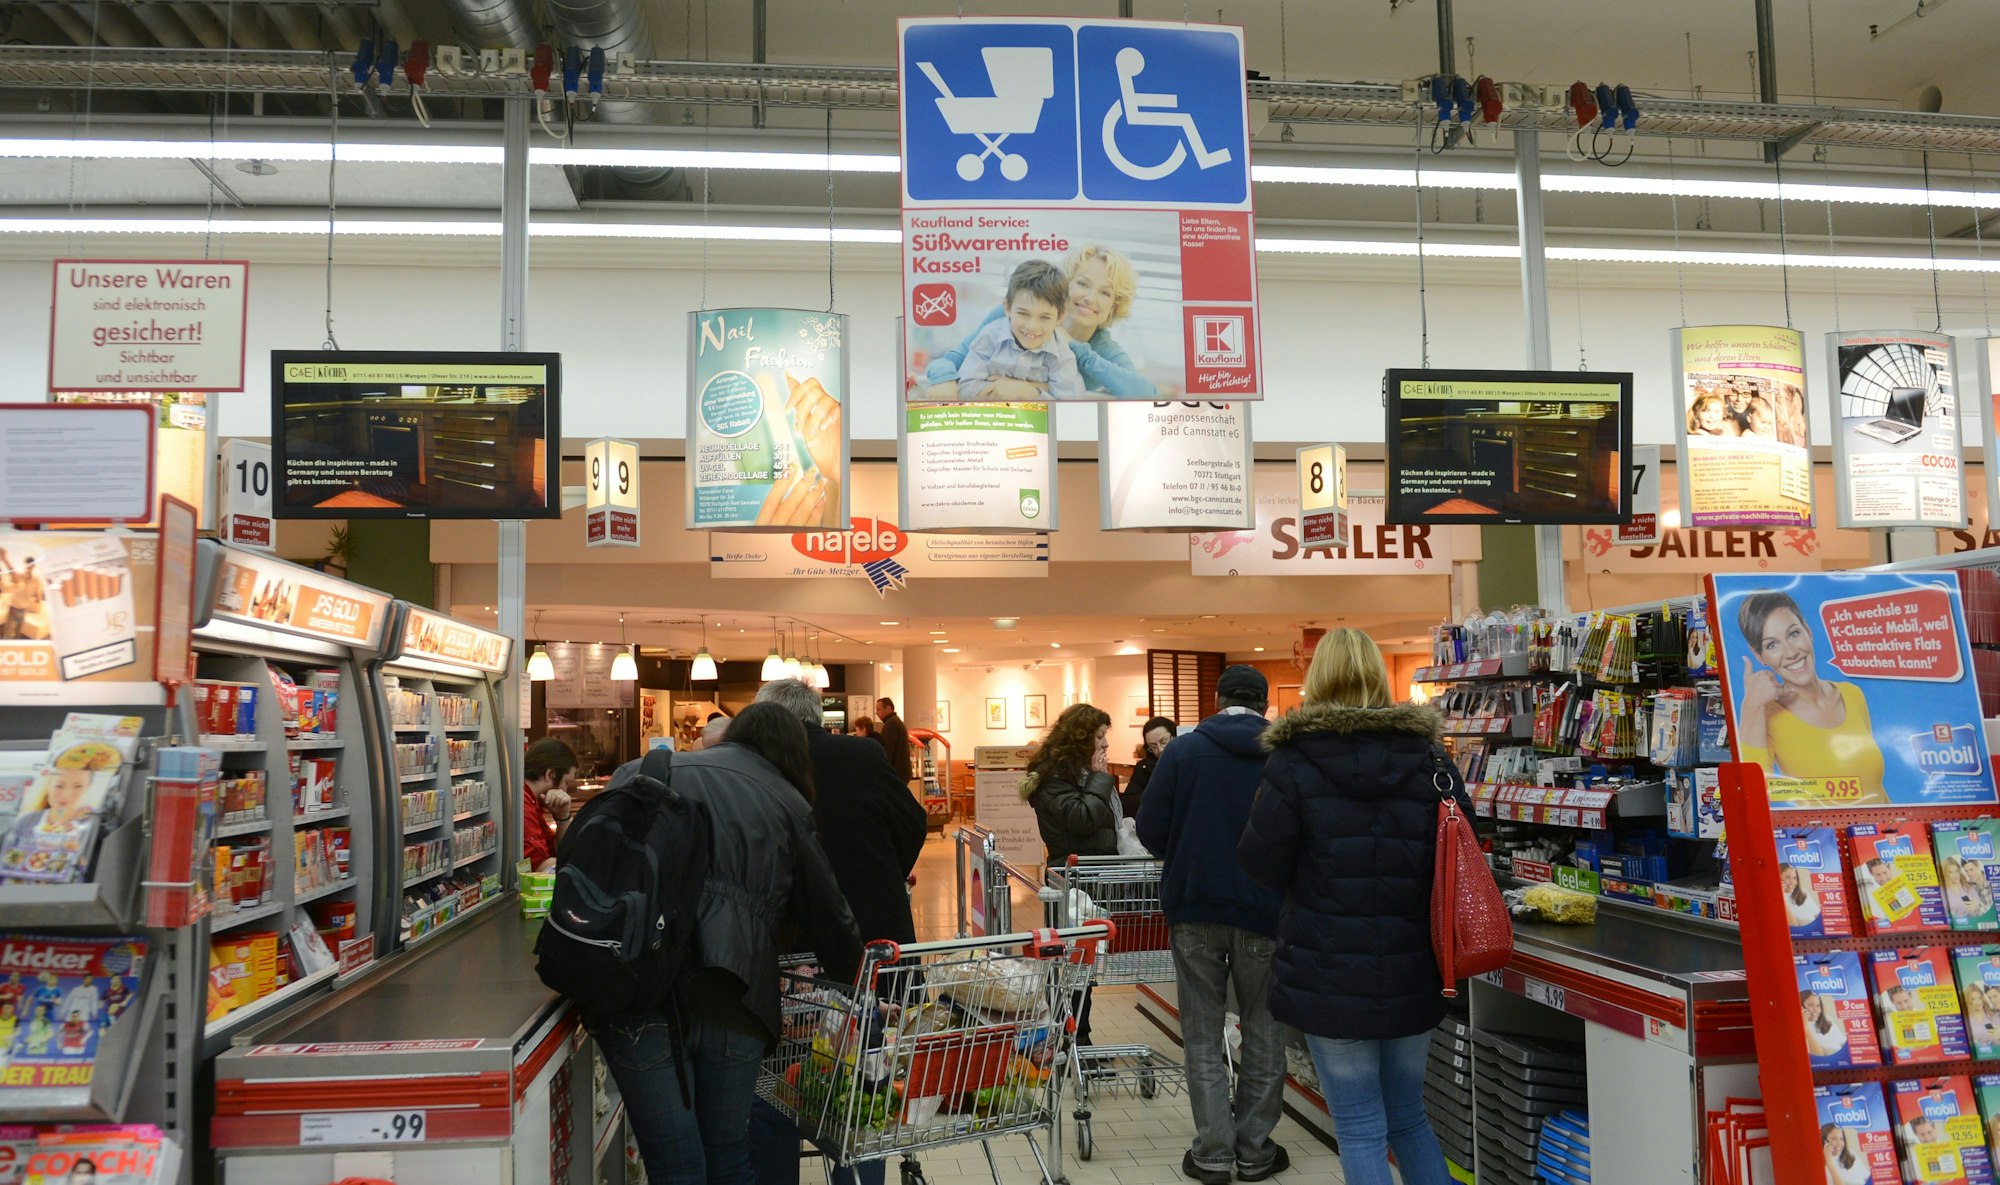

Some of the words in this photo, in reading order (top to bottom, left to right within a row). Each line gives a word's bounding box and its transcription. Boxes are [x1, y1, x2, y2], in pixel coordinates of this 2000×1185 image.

[911, 216, 973, 228] Kaufland
[978, 216, 1029, 228] Service:
[1181, 217, 1199, 225] Liebe
[1207, 225, 1226, 233] finden
[912, 232, 1069, 252] Süßwarenfreie
[912, 256, 981, 273] Kasse!
[70, 268, 148, 288] Unsere
[156, 269, 231, 289] Waren
[93, 297, 120, 311] sind
[125, 297, 206, 311] elektronisch
[93, 319, 202, 347] gesichert!
[699, 315, 755, 357] Nail
[1686, 343, 1703, 351] Wir
[1705, 339, 1729, 352] helfen
[119, 350, 175, 363] Sichtbar
[744, 346, 816, 369] Fashion
[1198, 354, 1242, 363] Kaufland
[1694, 354, 1712, 363] und
[1713, 354, 1736, 362] deren
[1738, 353, 1761, 362] Eltern
[96, 369, 122, 383] und
[126, 369, 197, 383] unsichtbar
[1198, 373, 1216, 383] Hier
[1217, 370, 1231, 379] bin
[1209, 380, 1222, 390] ich
[1222, 373, 1252, 388] richtig!
[1148, 413, 1235, 425] Baugenossenschaft
[1161, 426, 1180, 436] Bad
[1183, 427, 1226, 437] Cannstatt
[1228, 429, 1240, 438] eG
[700, 442, 760, 453] NEUMODELLAGE
[287, 458, 313, 466] Küchen
[327, 459, 365, 468] inspirieren
[700, 452, 743, 463] AUFFÜLLEN
[1187, 458, 1233, 468] Seelbergstraße
[1921, 454, 1957, 469] COCOX
[700, 463, 726, 472] UV-GEL
[773, 461, 783, 470] 40
[236, 459, 268, 496] 10
[287, 468, 319, 478] Germany
[320, 468, 334, 476] und
[360, 468, 393, 478] Beratung
[592, 456, 600, 491] 9
[618, 460, 629, 495] 9
[700, 471, 769, 482] ZEHENMODELLAGE
[773, 471, 783, 479] 35
[1214, 472, 1241, 481] Stuttgart
[1310, 461, 1323, 494] 8
[1401, 469, 1423, 477] Küchen
[1424, 469, 1434, 477] die
[1434, 469, 1467, 478] inspirieren
[1471, 469, 1488, 477] made
[1489, 469, 1495, 477] in
[287, 478, 302, 487] gibt
[1401, 478, 1428, 486] Germany
[1463, 478, 1491, 486] Beratung
[1401, 486, 1413, 495] gibt
[1172, 495, 1242, 504] www.bgc-cannstatt.de
[1168, 507, 1243, 516] info@bgc-cannstatt.de
[233, 517, 251, 527] Bitte
[251, 519, 270, 528] nicht
[1303, 519, 1317, 527] Bitte
[1318, 516, 1333, 524] nicht
[1637, 515, 1655, 524] nicht
[241, 528, 261, 536] mehr
[1310, 525, 1327, 533] mehr
[311, 594, 334, 617] JPS
[332, 598, 360, 622] GOLD
[1855, 602, 1902, 620] wechsle
[1904, 602, 1919, 614] zu
[1831, 622, 1883, 638] K-Classic
[1886, 619, 1922, 635] Mobil,
[1923, 616, 1949, 631] weil
[1836, 641, 1853, 652] ich
[1855, 638, 1912, 653] attraktive
[1914, 636, 1942, 651] Flats
[0, 650, 50, 667] OLD
[1841, 656, 1896, 669] zubuchen
[1920, 746, 1975, 766] mobil
[1825, 780, 1860, 798] 9.95
[1881, 847, 1911, 858] mobil
[1961, 844, 1991, 855] mobil
[1789, 851, 1820, 863] mobil
[1557, 867, 1579, 889] feel
[1579, 879, 1590, 889] me!
[1818, 873, 1825, 883] 9
[1906, 872, 1928, 882] 12,95
[1825, 892, 1835, 901] 10
[1, 943, 93, 970] kicker
[1811, 979, 1843, 990] mobil
[1902, 973, 1933, 986] mobil
[1544, 985, 1564, 1009] 4.99
[1843, 1000, 1850, 1009] 9
[1927, 1000, 1949, 1010] 12,95
[1851, 1019, 1862, 1028] 10
[1924, 1103, 1956, 1117] mobil
[1834, 1109, 1867, 1123] mobil
[1866, 1133, 1873, 1142] 9
[1951, 1132, 1974, 1142] 12,95
[1875, 1152, 1884, 1161] 10
